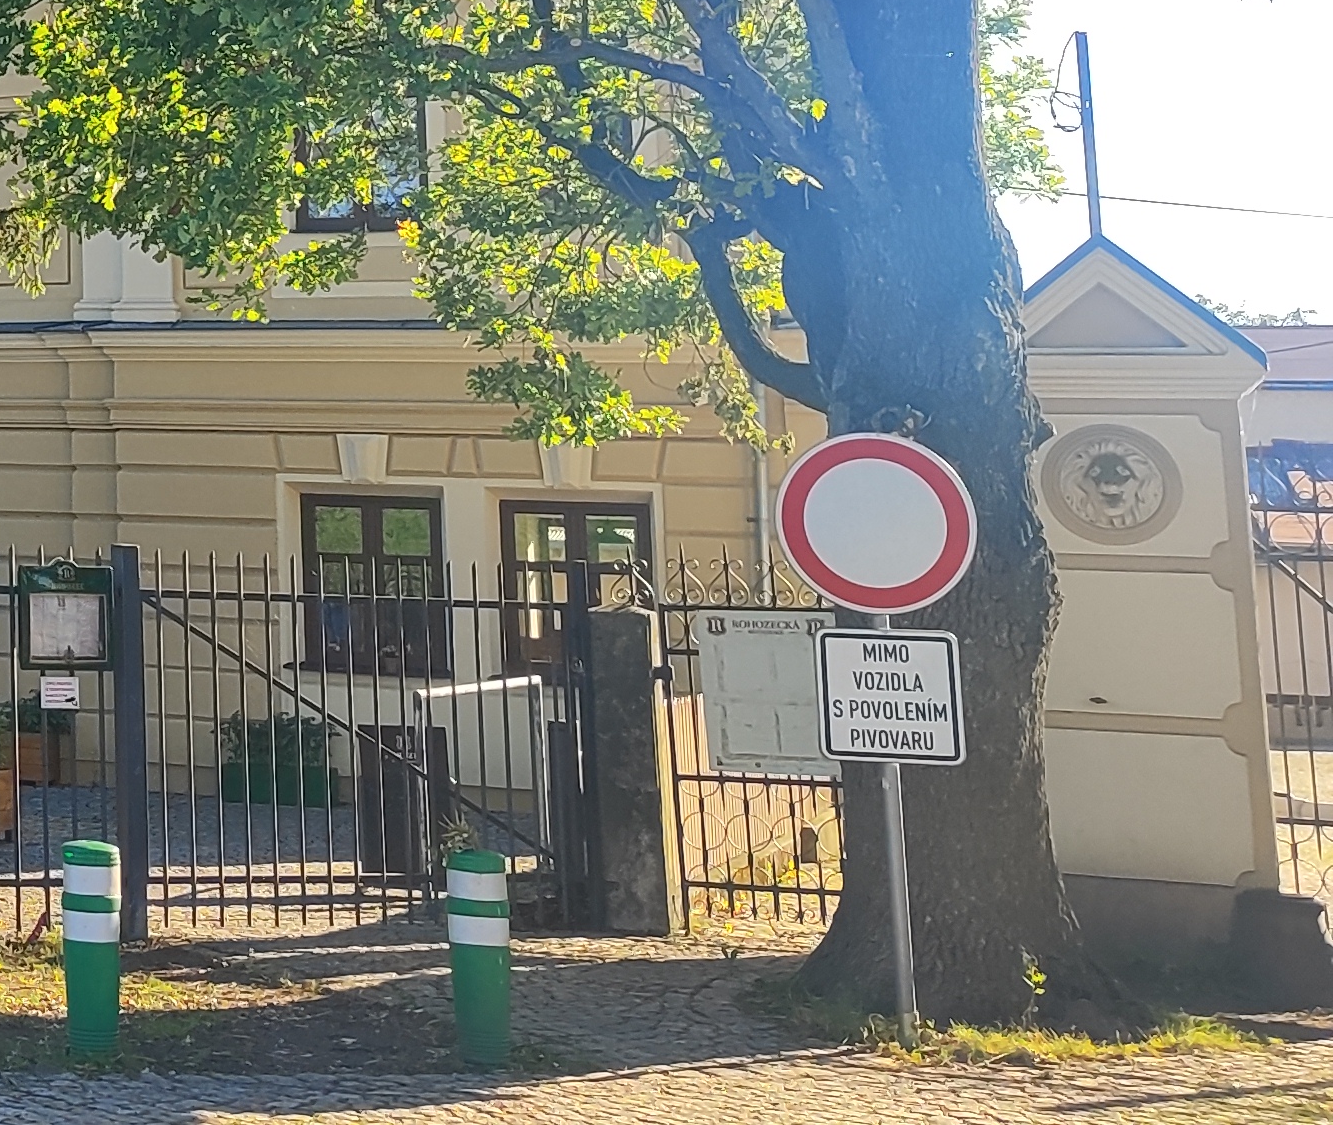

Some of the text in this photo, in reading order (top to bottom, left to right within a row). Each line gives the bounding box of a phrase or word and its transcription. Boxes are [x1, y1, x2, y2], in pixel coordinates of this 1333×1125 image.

[731, 619, 801, 631] ROHOZECKÁ
[862, 642, 910, 663] MIMO
[852, 670, 924, 692] VOZIDLA
[832, 697, 948, 722] S POVOLENÍM
[850, 728, 934, 750] PIVOVARU
